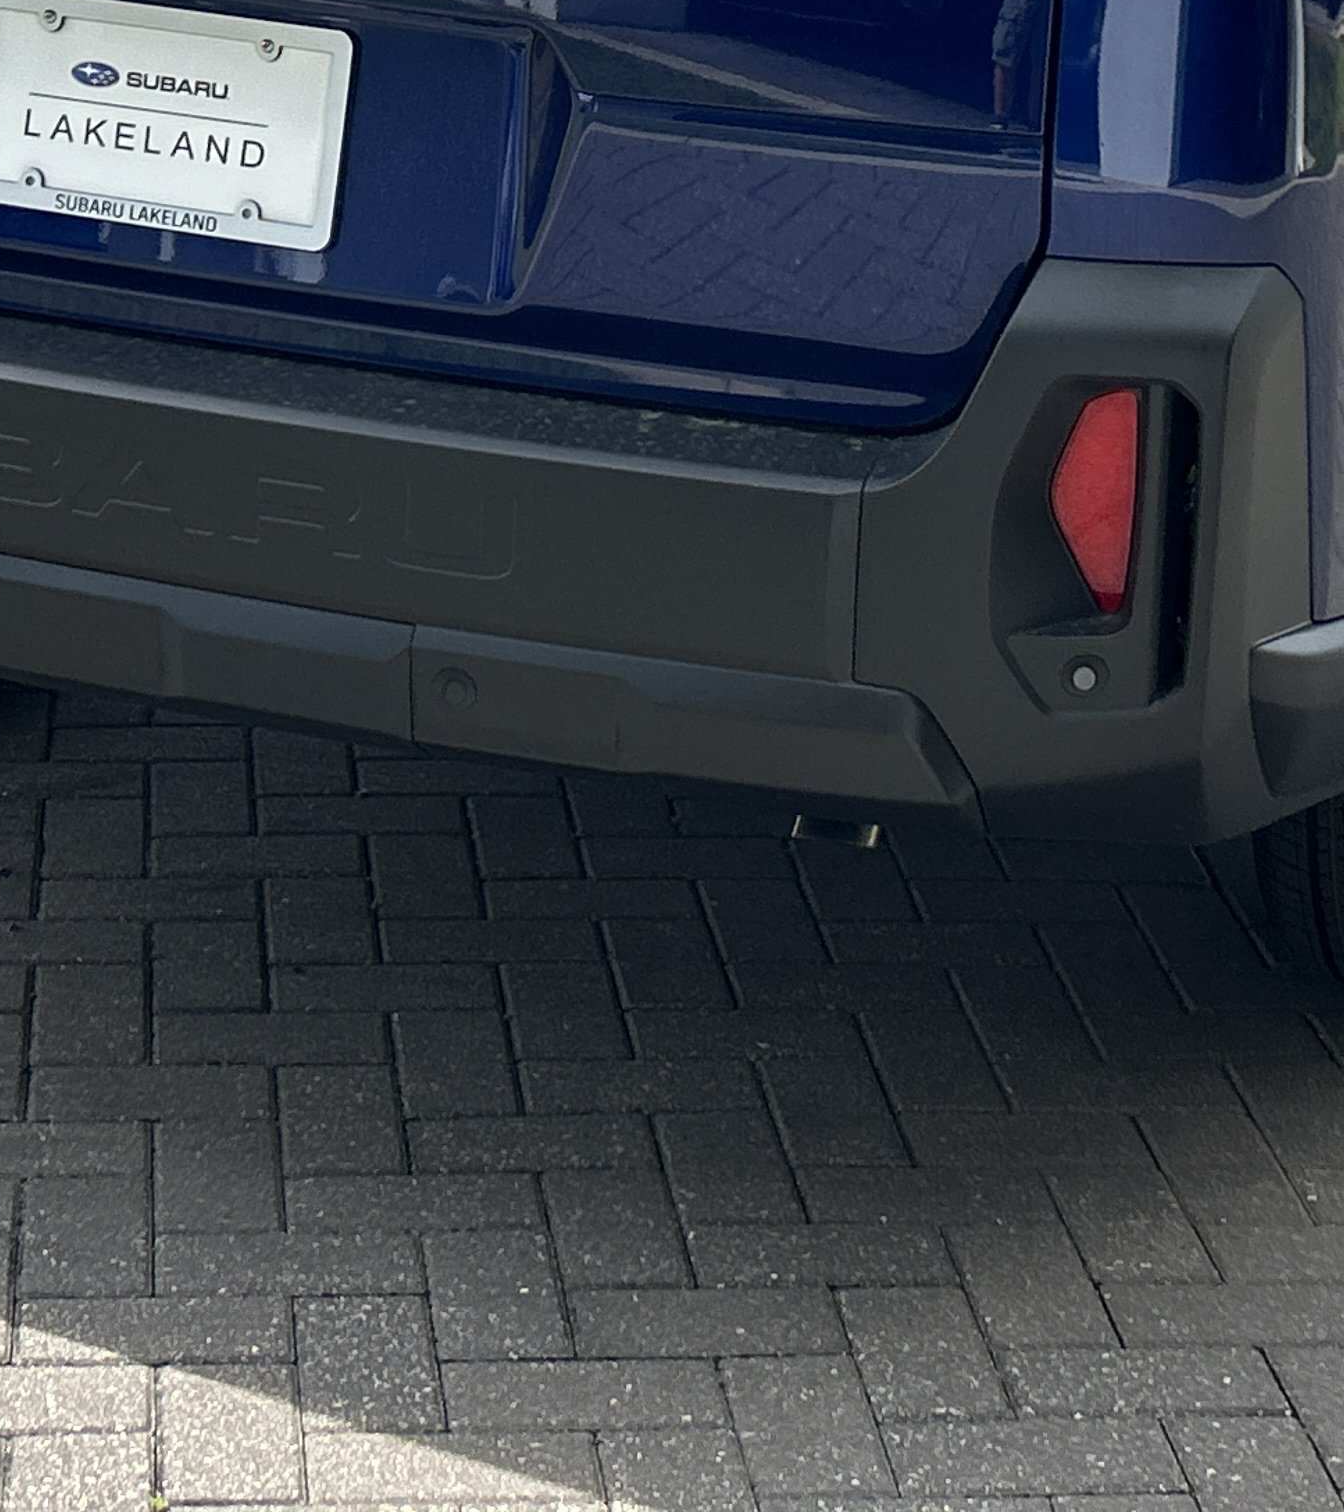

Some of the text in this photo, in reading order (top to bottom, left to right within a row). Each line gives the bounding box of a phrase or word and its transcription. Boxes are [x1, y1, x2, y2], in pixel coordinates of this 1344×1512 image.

[126, 71, 230, 100] SUBARU
[22, 107, 267, 169] LAKELAND
[54, 193, 219, 234] SUBARU LAKELAND
